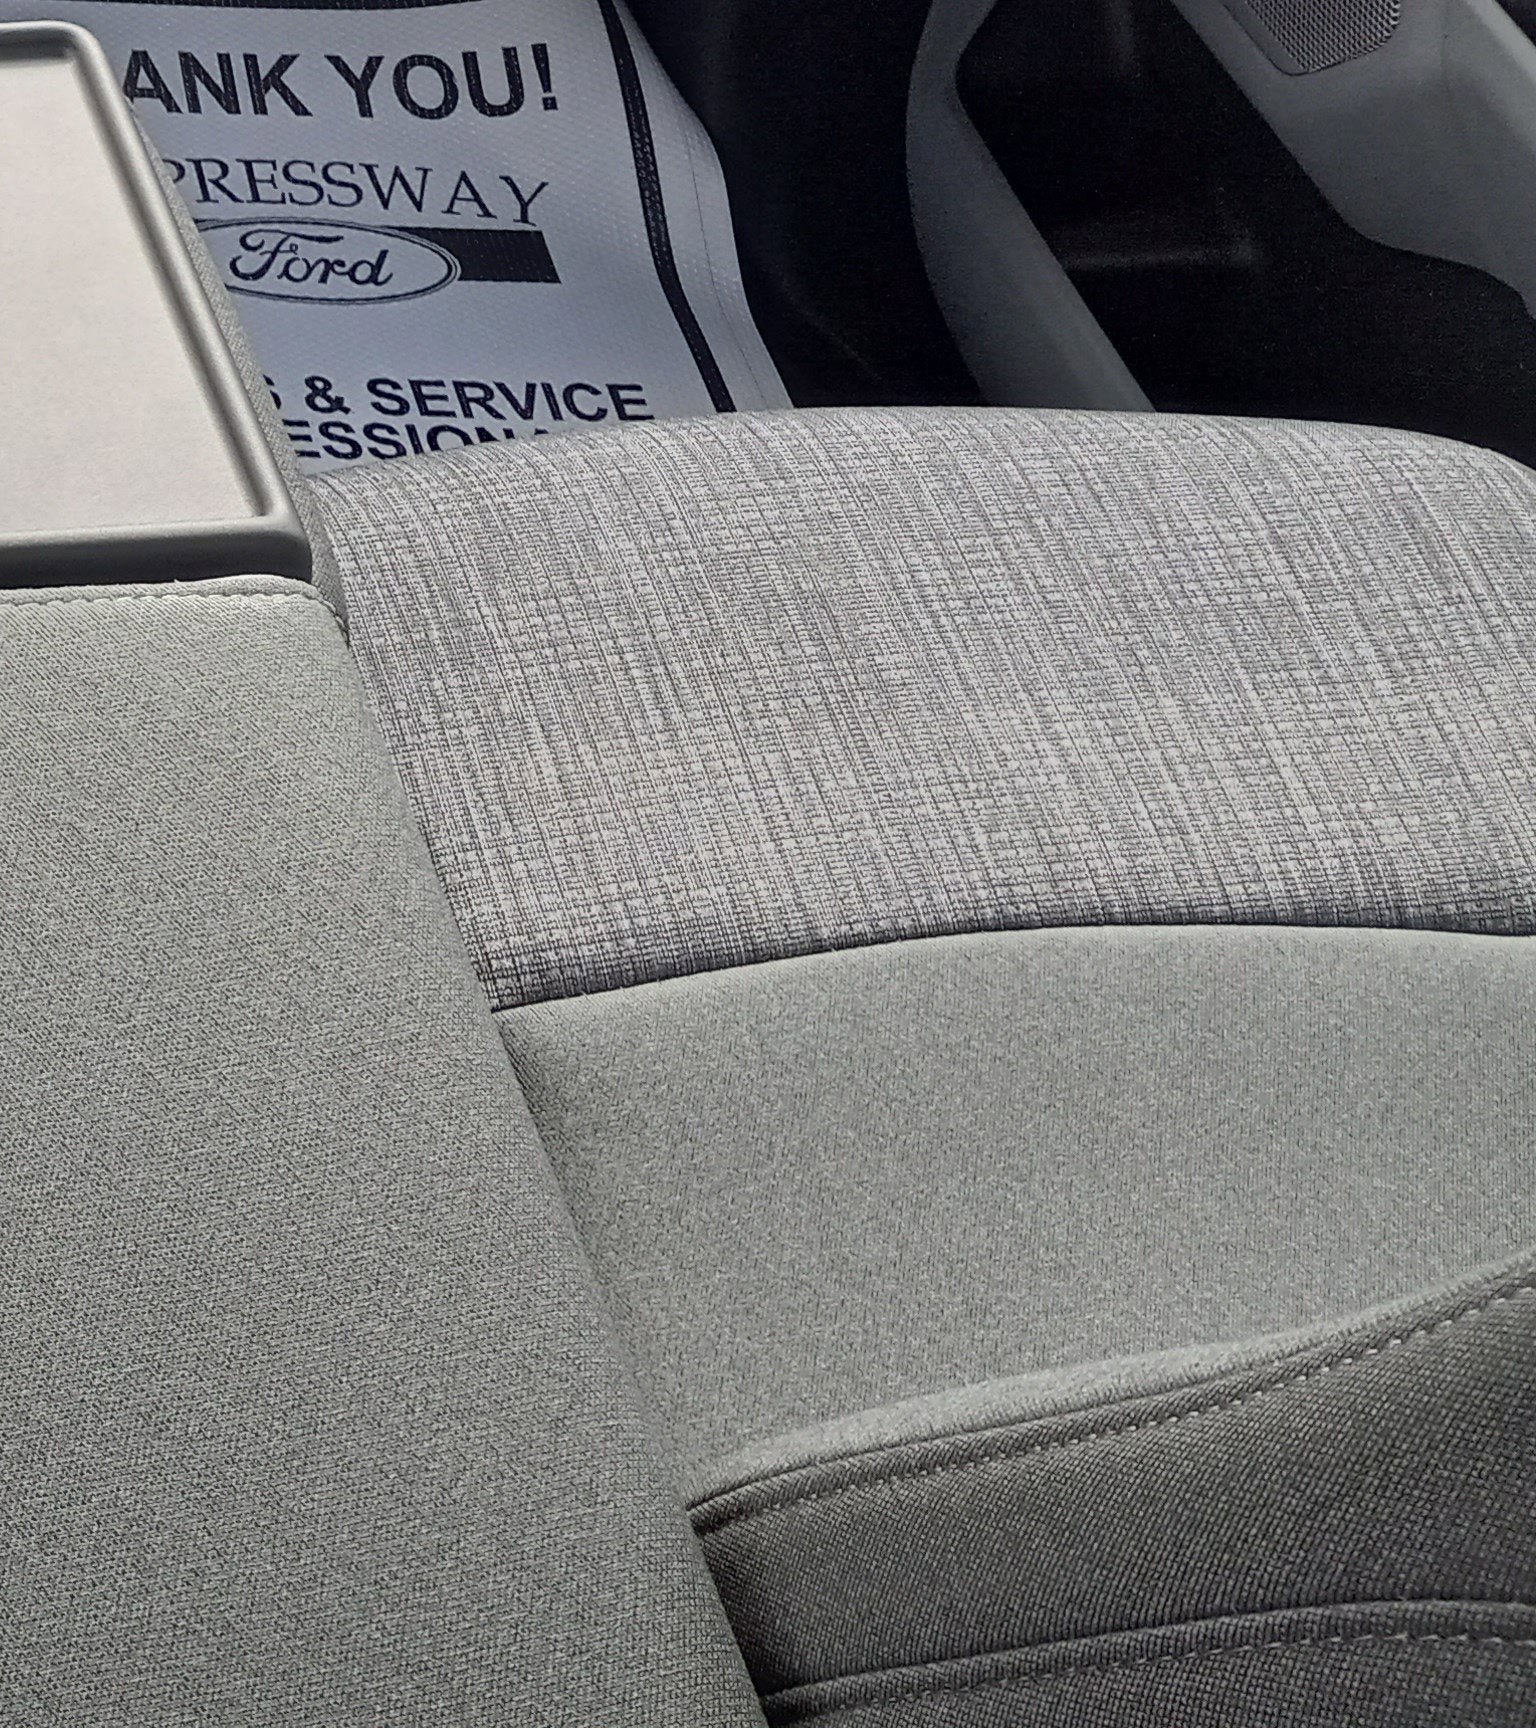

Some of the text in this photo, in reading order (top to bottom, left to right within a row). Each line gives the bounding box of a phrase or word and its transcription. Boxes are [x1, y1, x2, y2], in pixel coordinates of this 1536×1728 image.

[324, 43, 559, 119] YOU!
[228, 227, 394, 286] Ford
[304, 375, 351, 415] &
[366, 377, 656, 422] SERVICE
